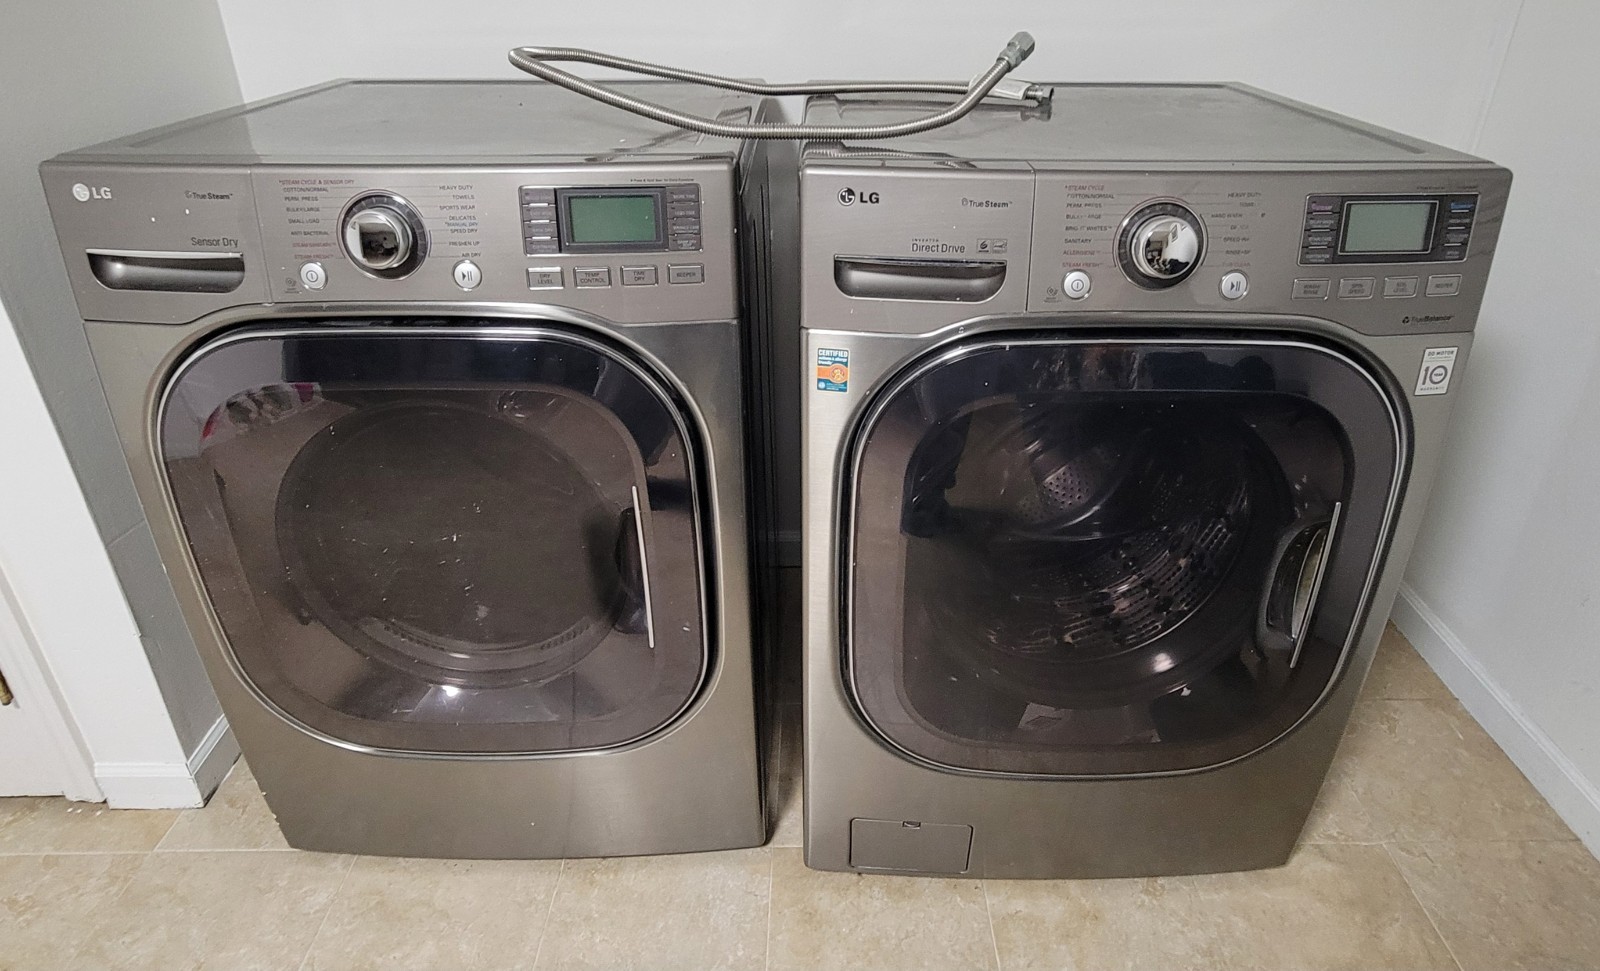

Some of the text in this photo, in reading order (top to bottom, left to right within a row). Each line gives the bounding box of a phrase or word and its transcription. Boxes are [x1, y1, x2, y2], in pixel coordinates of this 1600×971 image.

[91, 187, 112, 199] LG
[860, 192, 880, 204] LG
[190, 236, 238, 248] Sensor Dry
[911, 242, 965, 253] Direct Drive
[818, 349, 848, 358] CERTIFIED
[1422, 365, 1448, 385] 10
